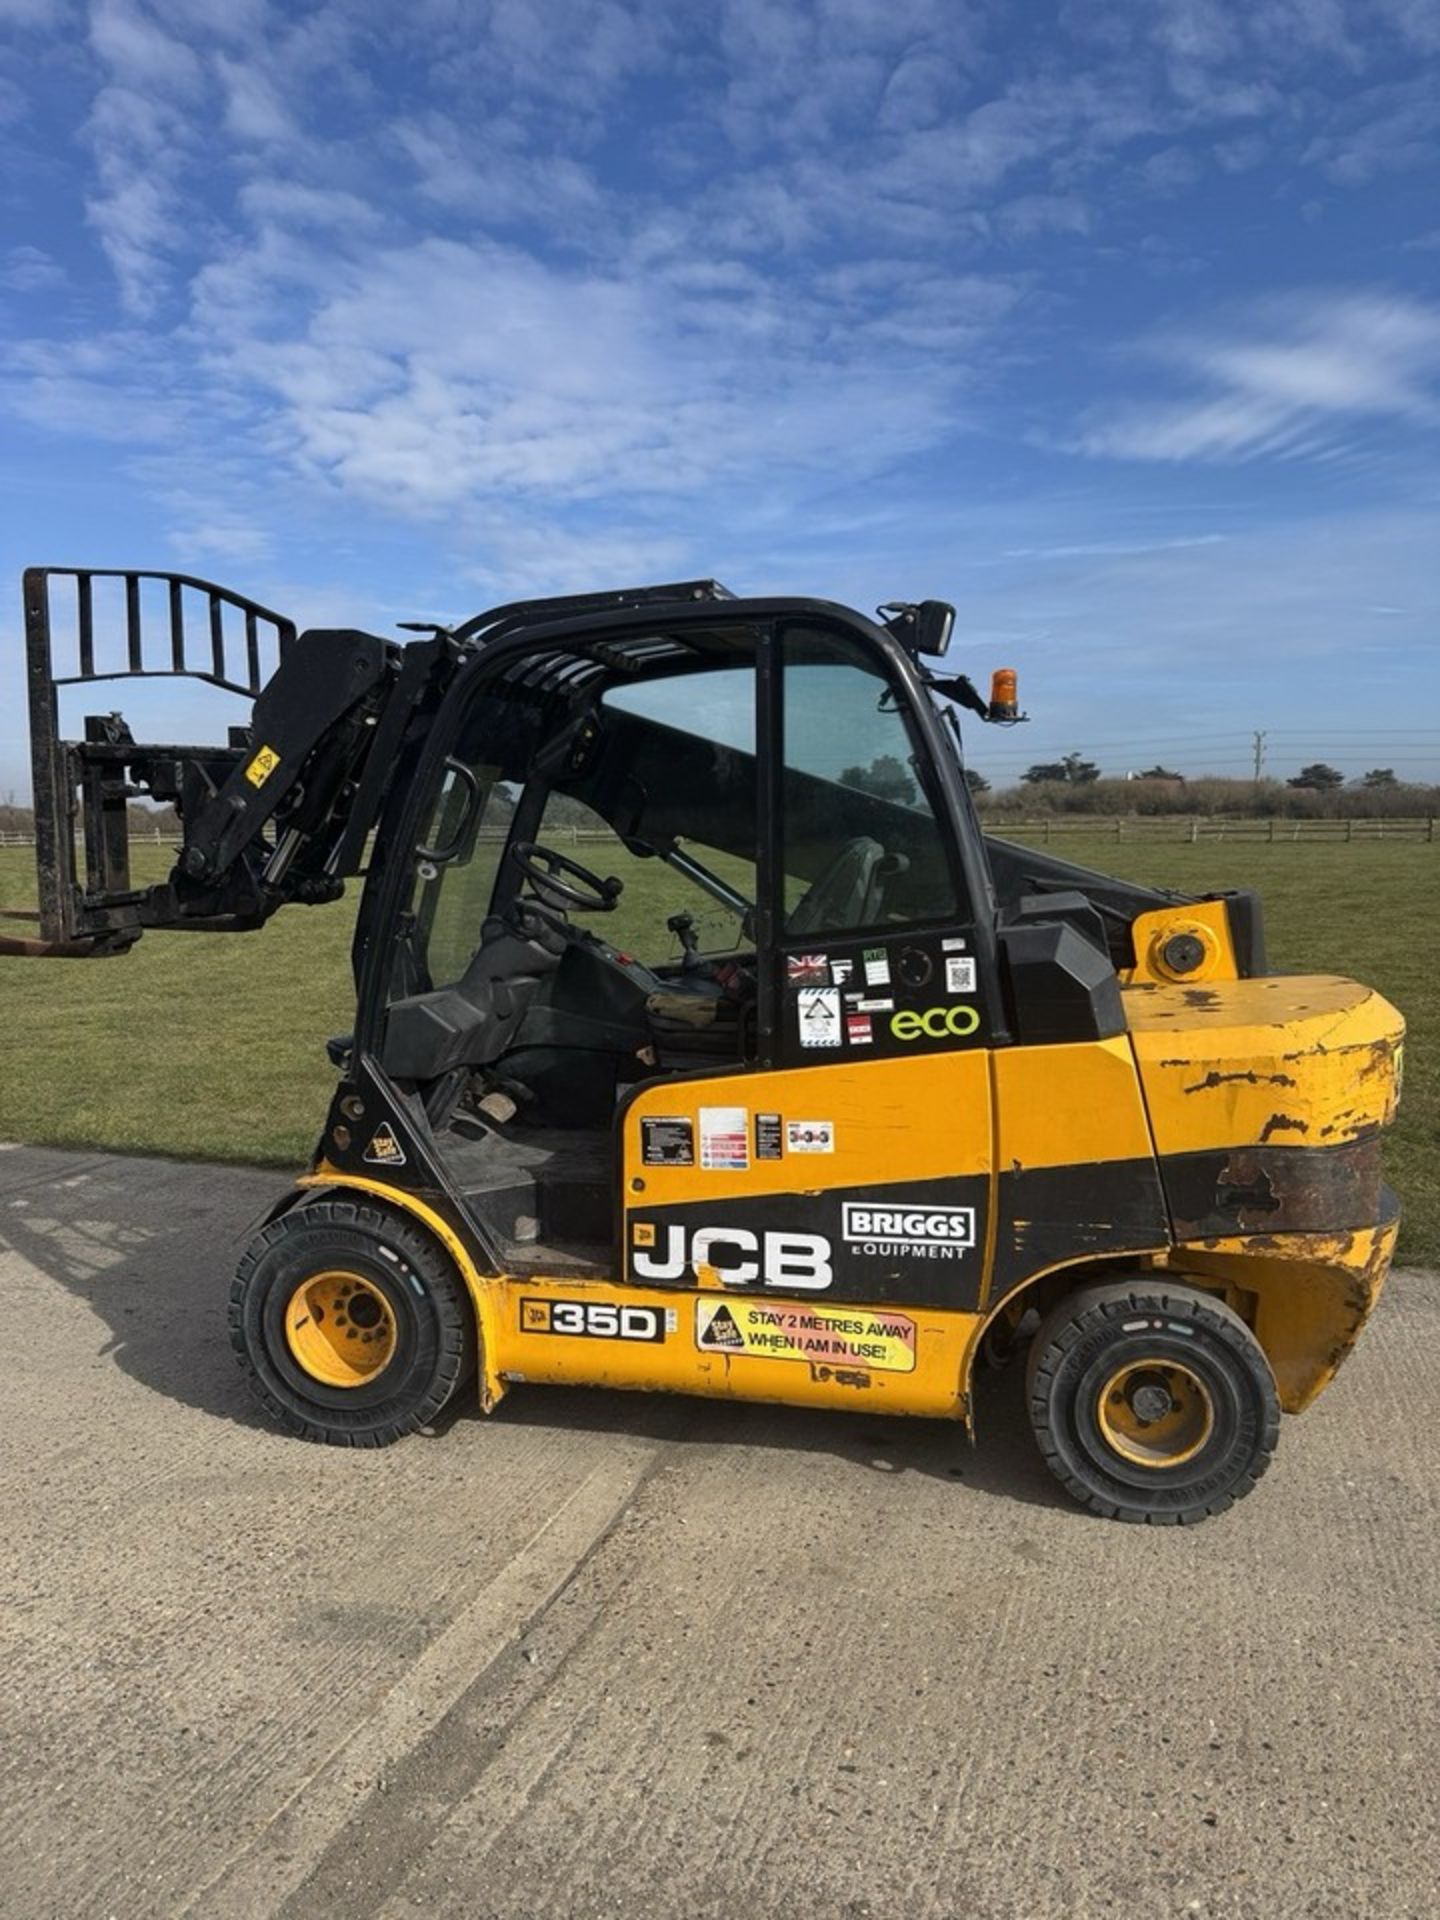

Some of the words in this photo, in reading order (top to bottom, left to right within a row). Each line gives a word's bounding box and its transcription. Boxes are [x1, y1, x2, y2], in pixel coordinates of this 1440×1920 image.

[890, 1005, 981, 1041] eco
[851, 1211, 967, 1238] BRIGGS
[633, 1225, 834, 1290] JCB
[851, 1243, 968, 1260] EQUIPMENT
[552, 1302, 658, 1339] 35D
[748, 1310, 787, 1326] STAY
[788, 1315, 797, 1328] 2
[799, 1316, 863, 1334] METRES
[865, 1321, 912, 1340] AWAY
[748, 1332, 796, 1349] WHEN
[805, 1338, 830, 1352] AM
[831, 1341, 847, 1355] IN
[850, 1343, 887, 1360] USE!
